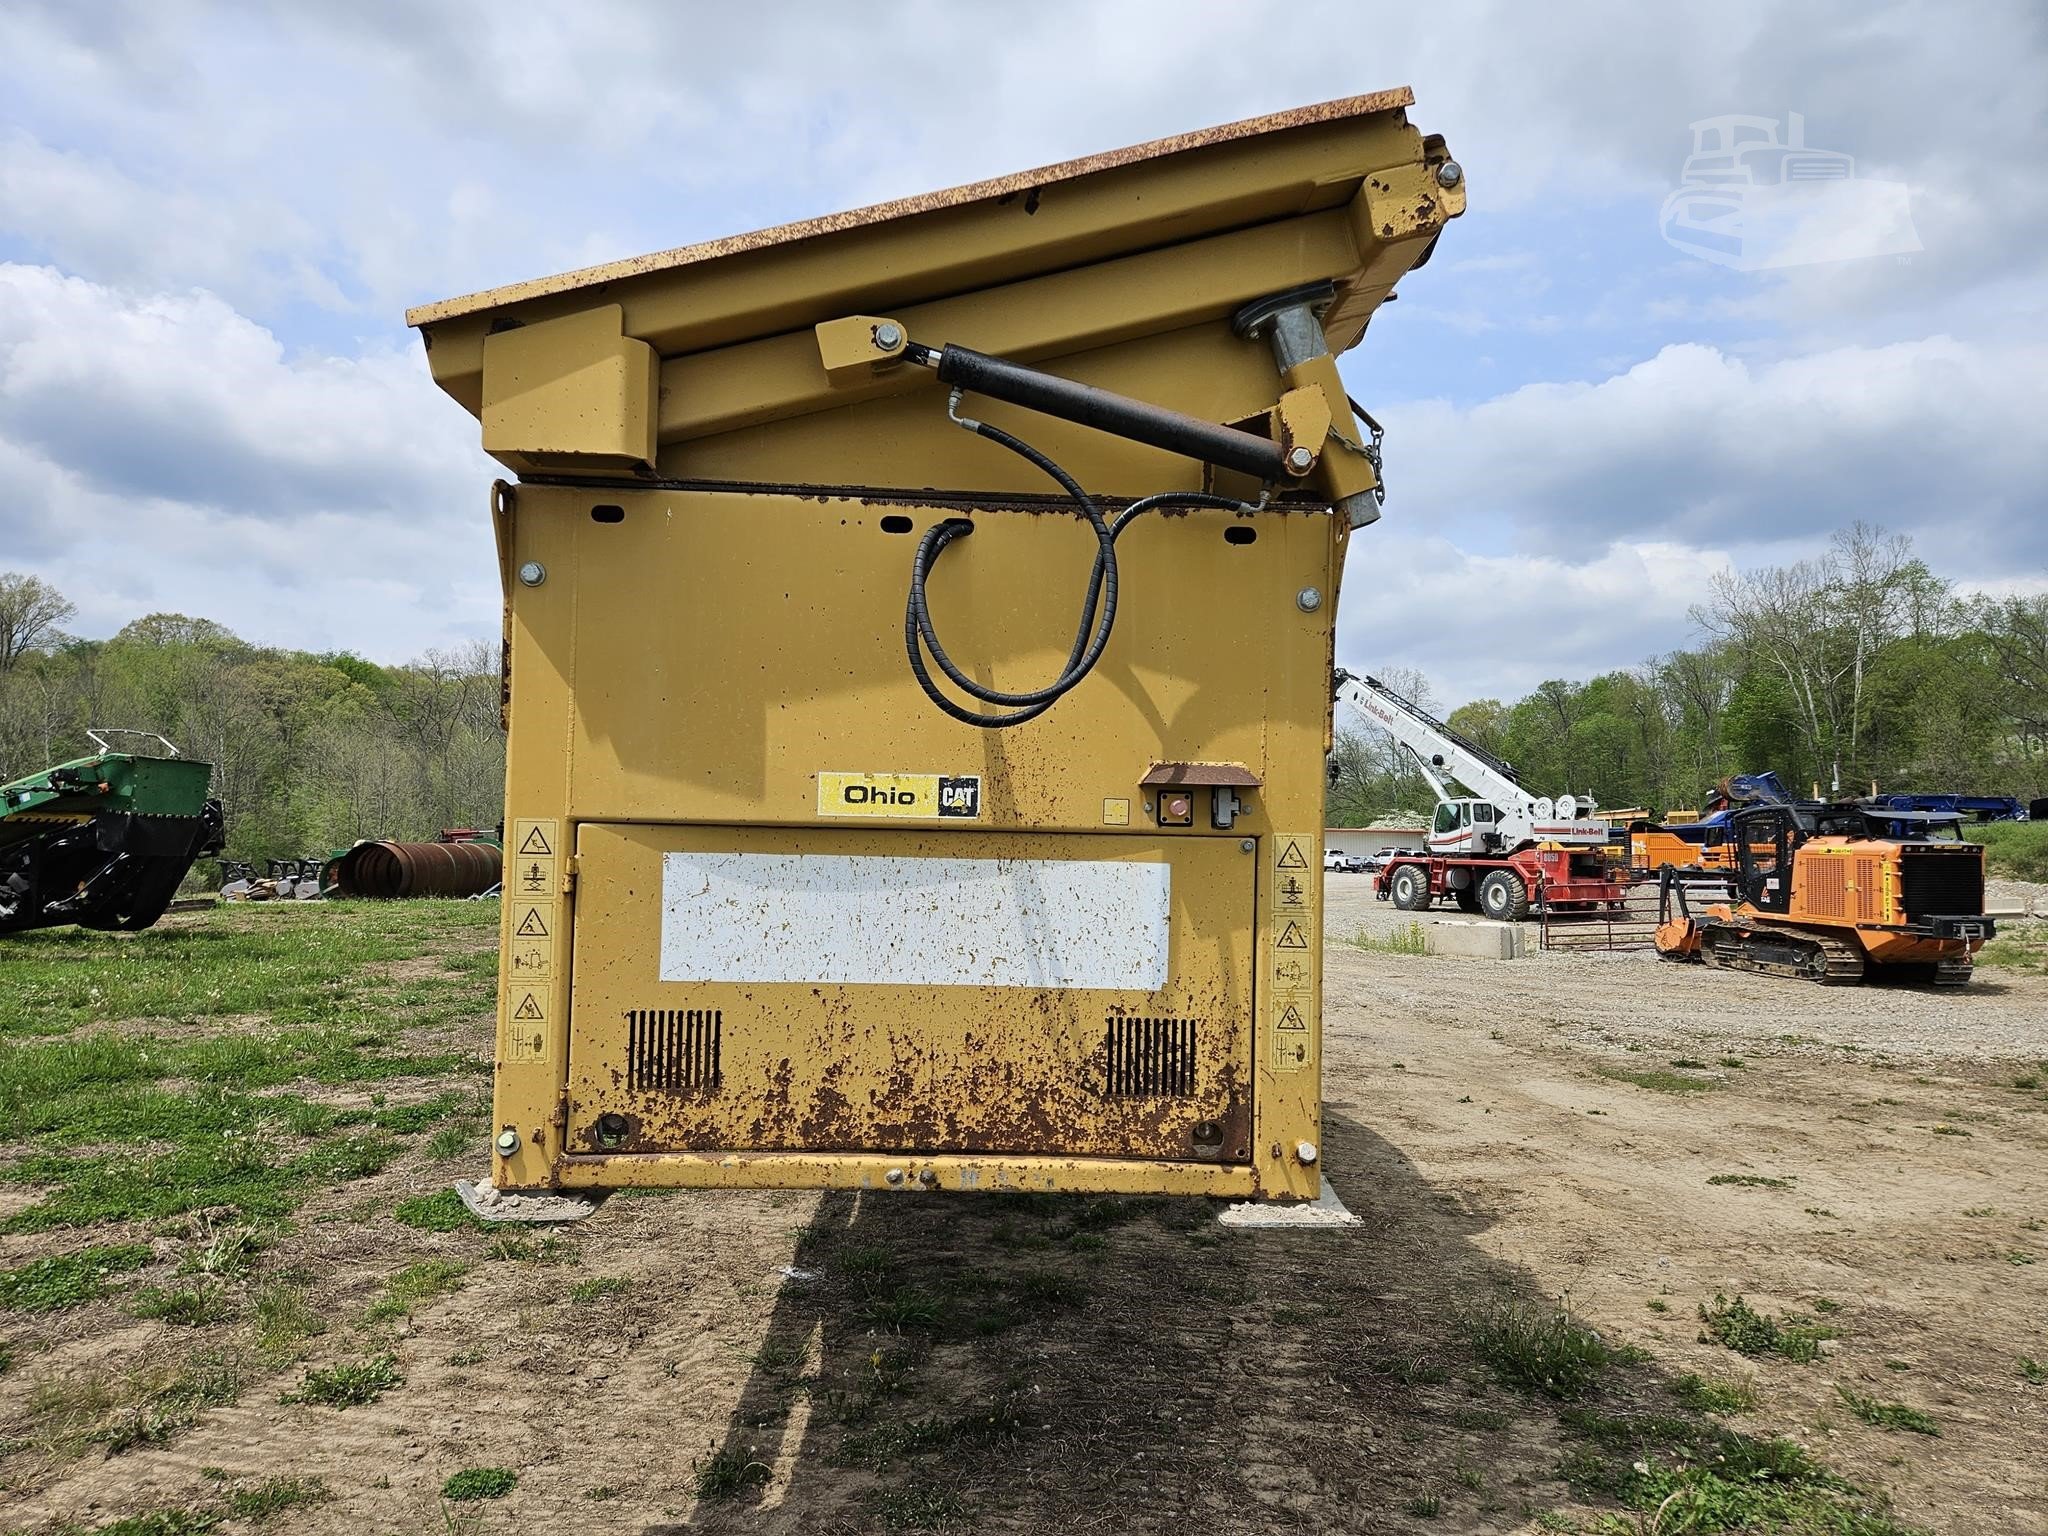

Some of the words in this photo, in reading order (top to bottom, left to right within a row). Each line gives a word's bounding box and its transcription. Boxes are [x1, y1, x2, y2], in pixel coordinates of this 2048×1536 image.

[1364, 699, 1394, 726] Link-Belt
[844, 785, 915, 805] Ohio
[942, 787, 975, 807] CAT
[1571, 827, 1603, 836] Link-Belt
